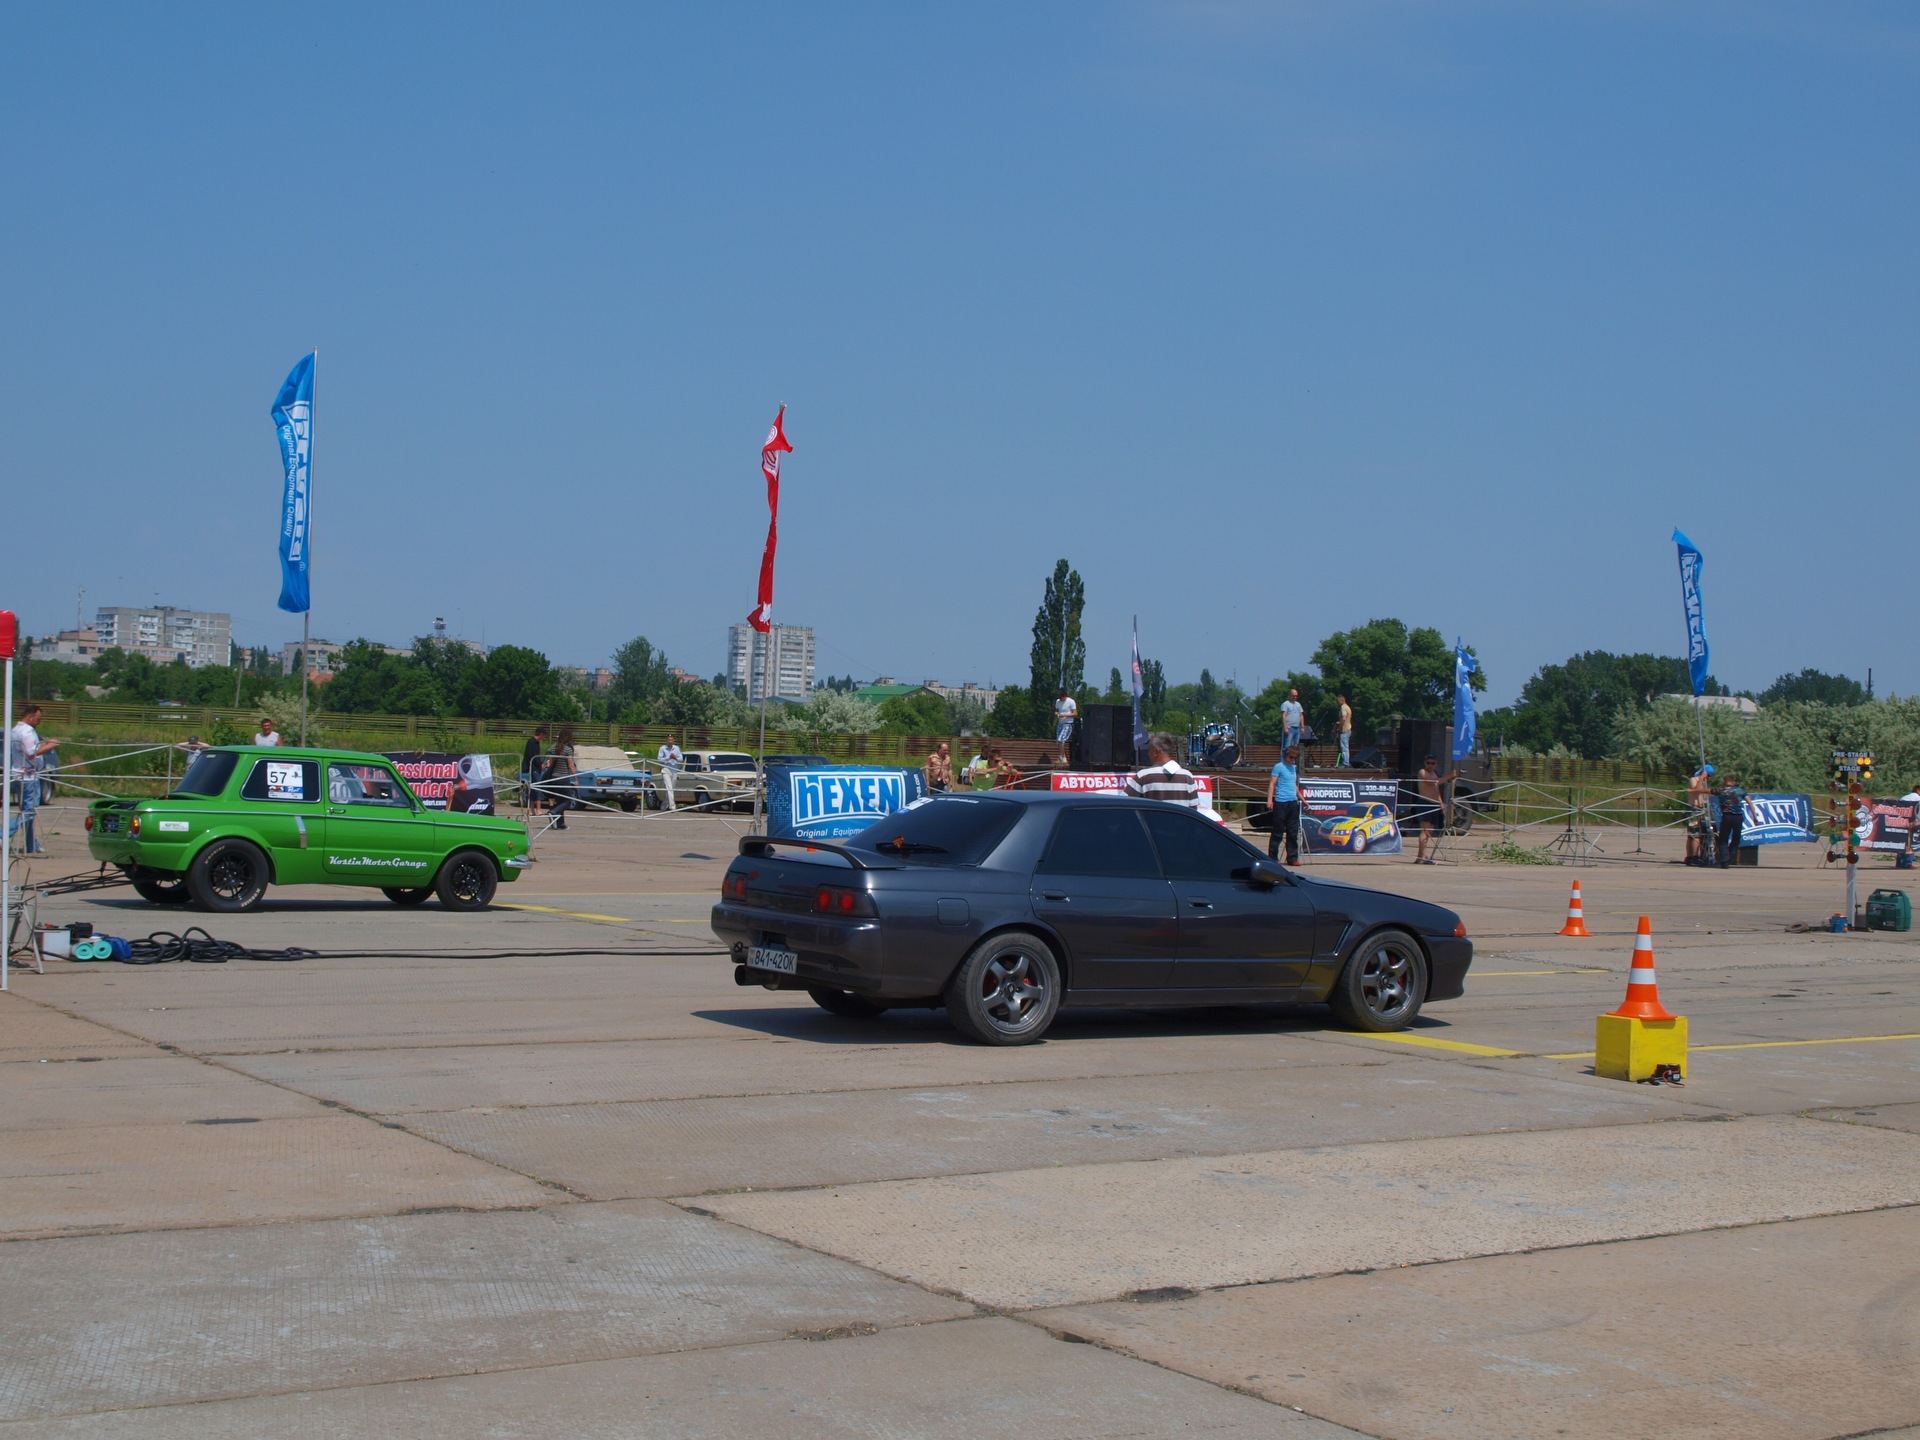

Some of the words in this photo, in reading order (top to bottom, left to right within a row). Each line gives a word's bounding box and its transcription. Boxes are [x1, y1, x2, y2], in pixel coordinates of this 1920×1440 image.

[286, 457, 297, 504] Equipment
[284, 506, 294, 538] Quality
[269, 771, 287, 784] 57
[796, 829, 828, 839] Original
[1765, 831, 1791, 839] Equipment
